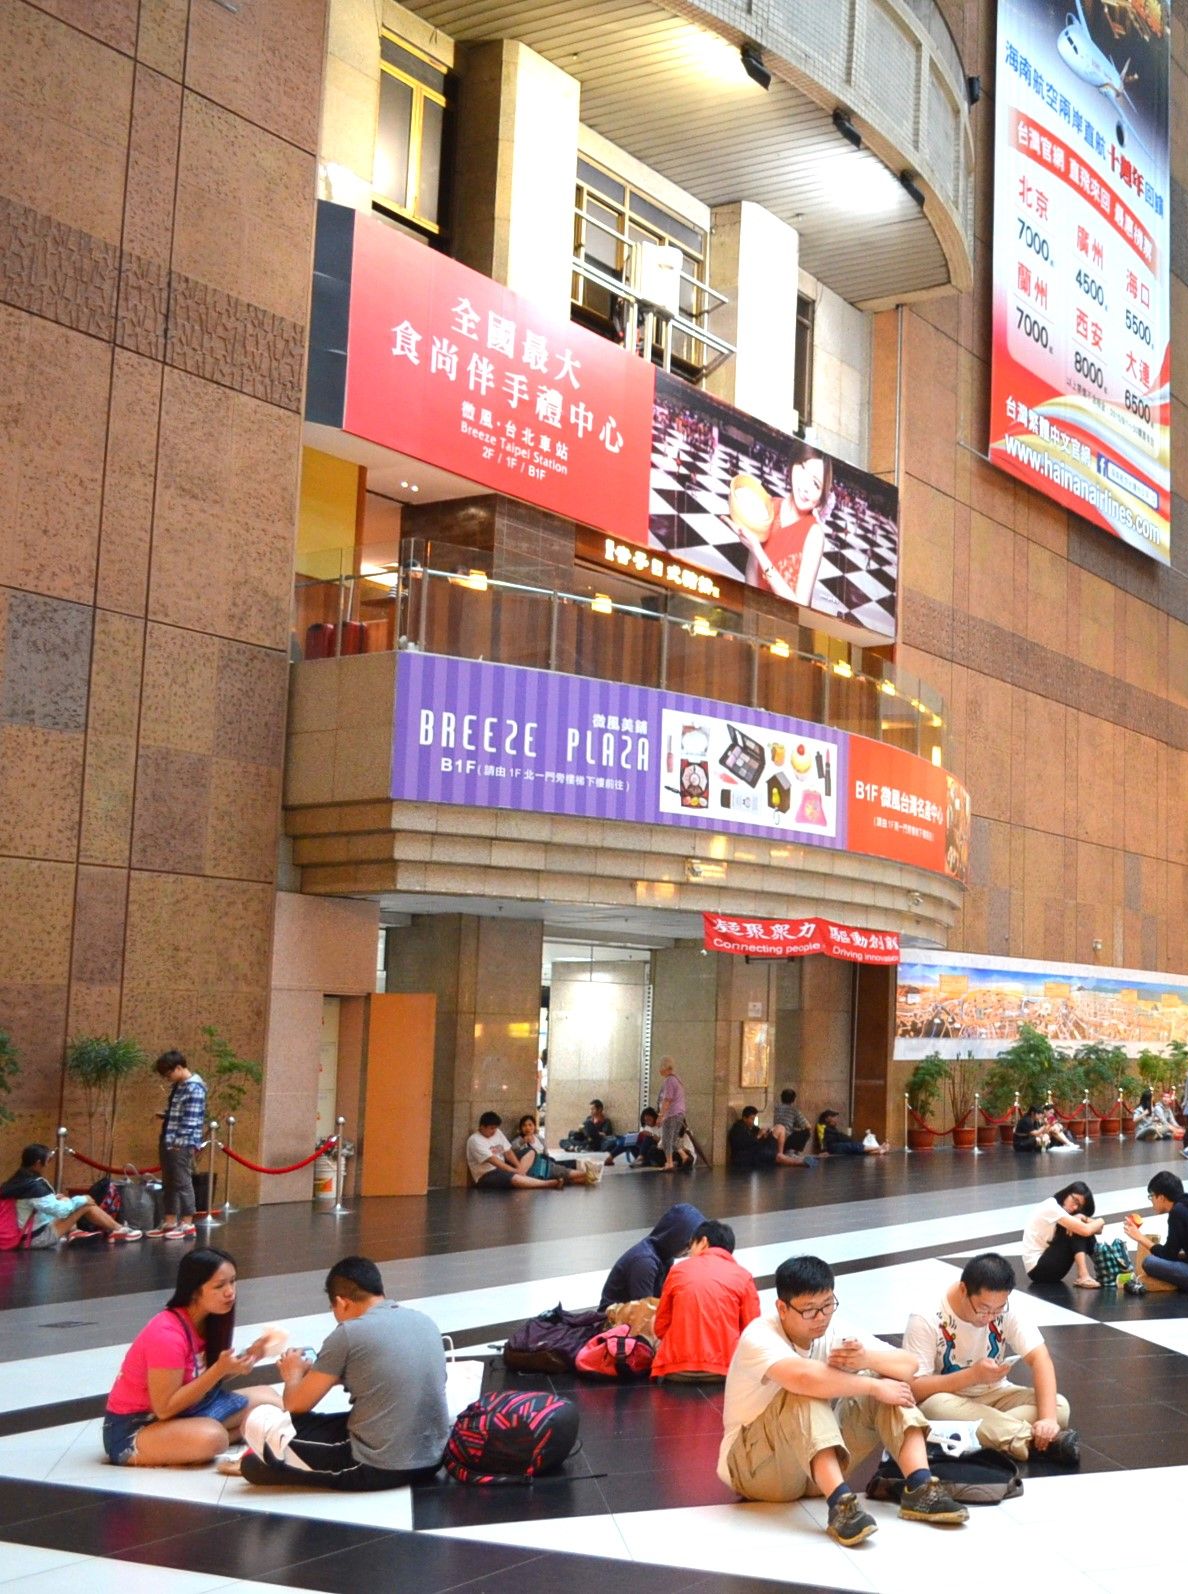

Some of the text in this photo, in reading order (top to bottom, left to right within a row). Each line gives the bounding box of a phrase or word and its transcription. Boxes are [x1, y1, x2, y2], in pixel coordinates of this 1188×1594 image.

[1018, 175, 1049, 221] 北京
[1017, 216, 1050, 263] 7000
[1077, 224, 1104, 271] 廣州
[1017, 261, 1048, 311] 蘭州
[1075, 269, 1104, 307] 4500
[1126, 269, 1150, 309] 海口
[451, 297, 581, 389] 全國最大
[1016, 306, 1049, 349] 7000
[1075, 307, 1103, 352] 西安
[391, 320, 624, 454] 食尚伴手禮中心
[1074, 351, 1104, 389] 8000
[1125, 351, 1150, 390] 大連
[461, 421, 567, 475] Breeze Taipei Station
[482, 446, 494, 460] 2F
[506, 456, 517, 470] 1F
[528, 465, 546, 481] B1F
[1004, 433, 1161, 546] www.hainanairlines.com
[419, 709, 649, 772] BREEZE PLAZA
[441, 757, 476, 775] B1F
[856, 780, 878, 802] B1F
[713, 938, 783, 955] Connecting
[832, 945, 863, 961] Driving
